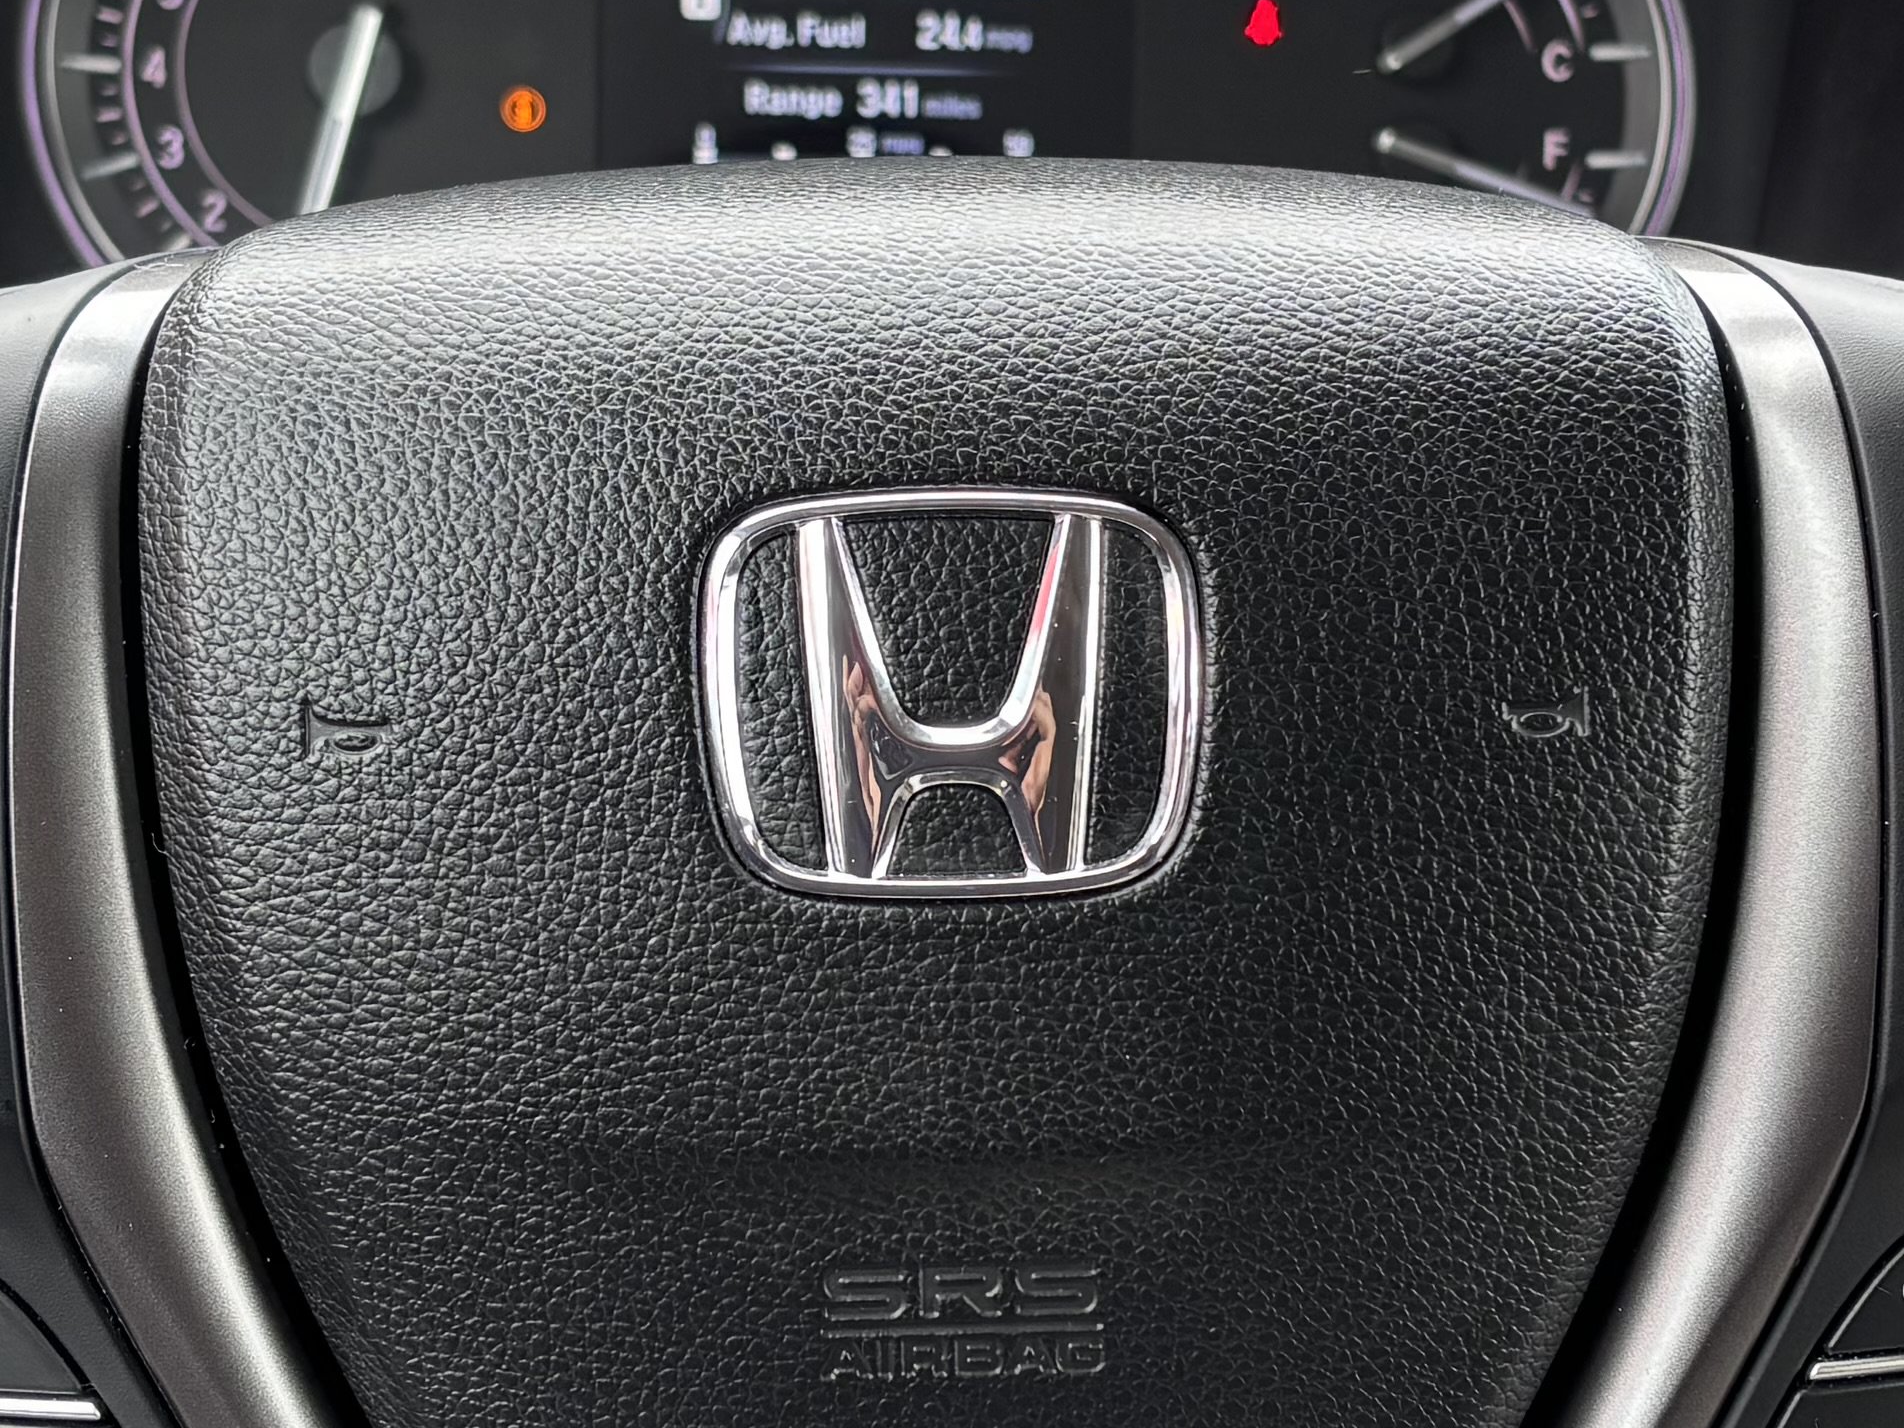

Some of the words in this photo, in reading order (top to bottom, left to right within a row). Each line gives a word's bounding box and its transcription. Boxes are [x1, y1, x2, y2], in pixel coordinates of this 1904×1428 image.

[796, 11, 866, 49] Fuel
[141, 47, 167, 90] 4
[1540, 39, 1575, 84] C
[743, 79, 843, 120] Range
[156, 127, 186, 170] 3
[1542, 128, 1569, 170] F
[200, 186, 229, 233] 2
[821, 1266, 1102, 1322] SRS
[821, 1338, 1105, 1381] AIRBAG
